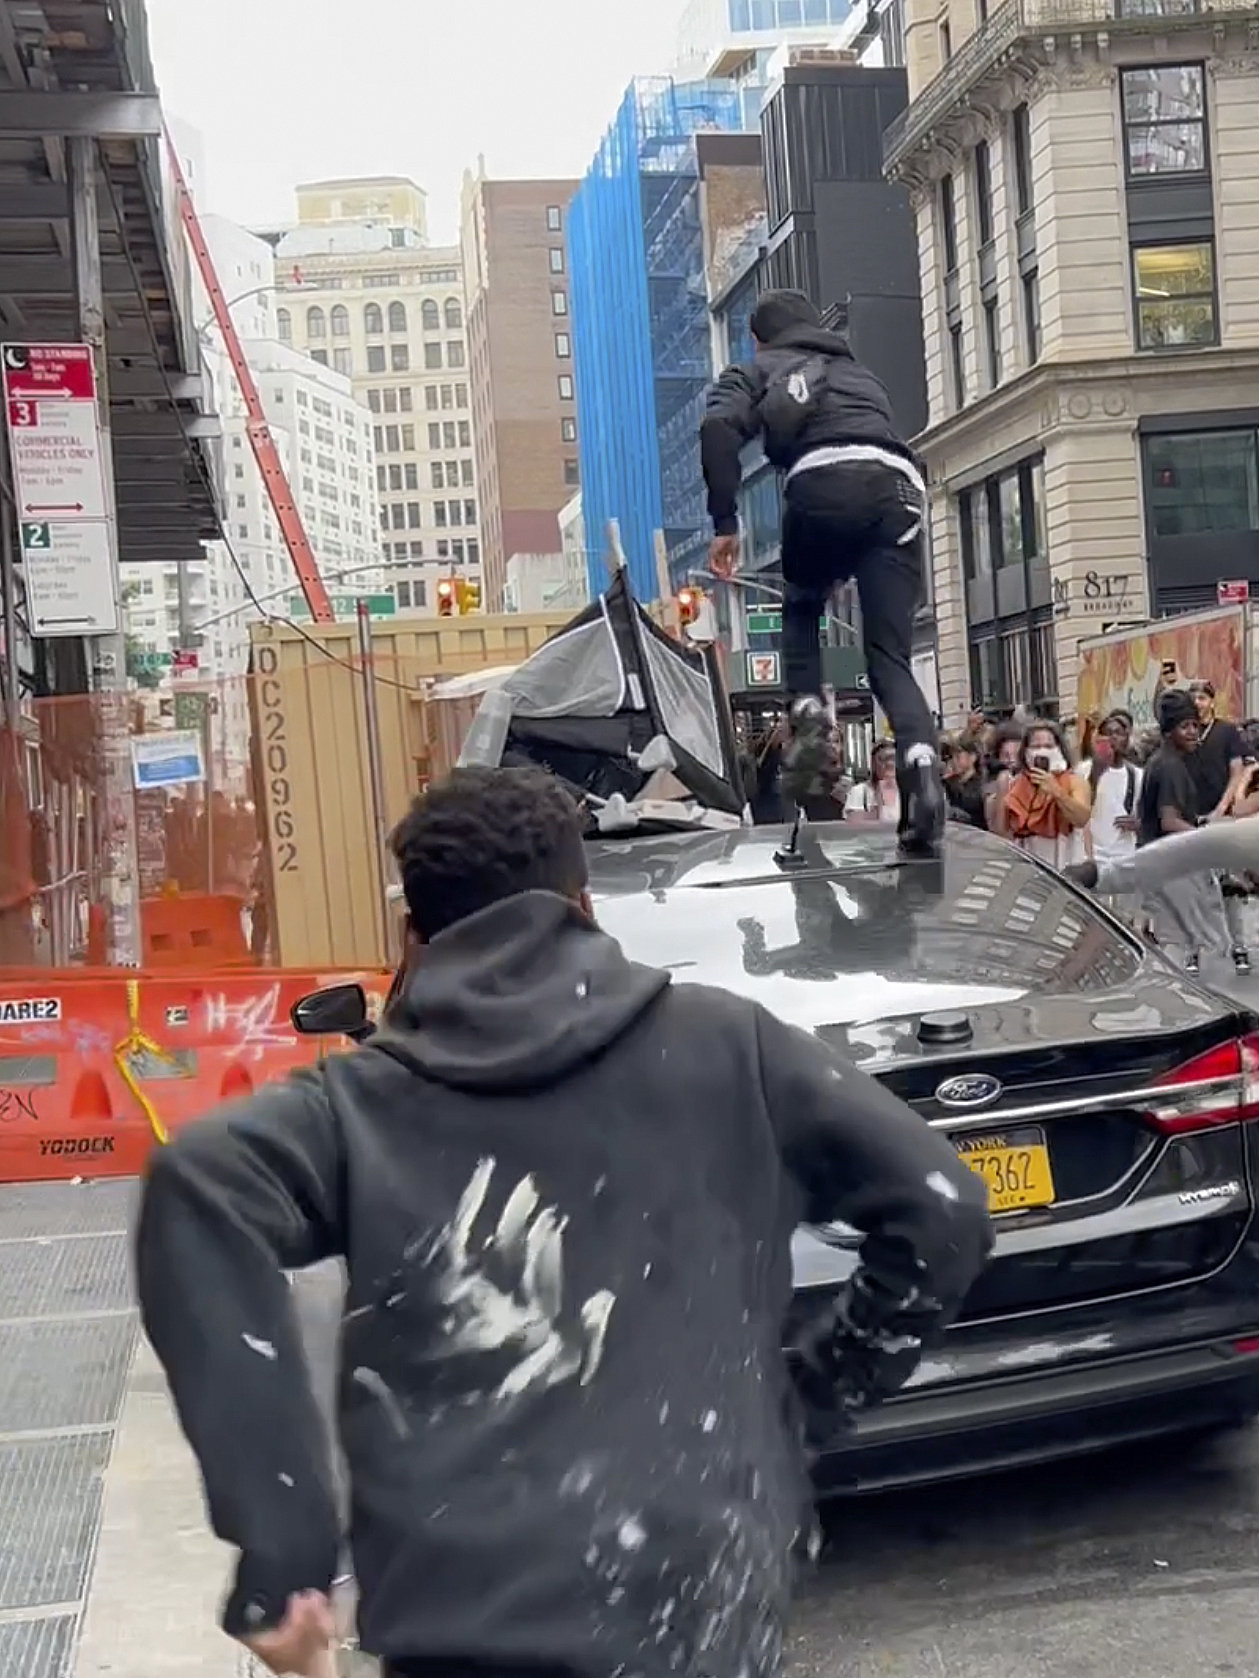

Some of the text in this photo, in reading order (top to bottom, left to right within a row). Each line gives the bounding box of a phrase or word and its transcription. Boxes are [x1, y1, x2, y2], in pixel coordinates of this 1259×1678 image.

[45, 349, 88, 359] STANDING
[16, 402, 31, 424] 3
[16, 436, 81, 446] COMMERCIAL
[68, 448, 94, 459] ONLY
[28, 525, 44, 546] 2
[1084, 571, 1128, 612] 817
[39, 1136, 115, 1156] YODOCK
